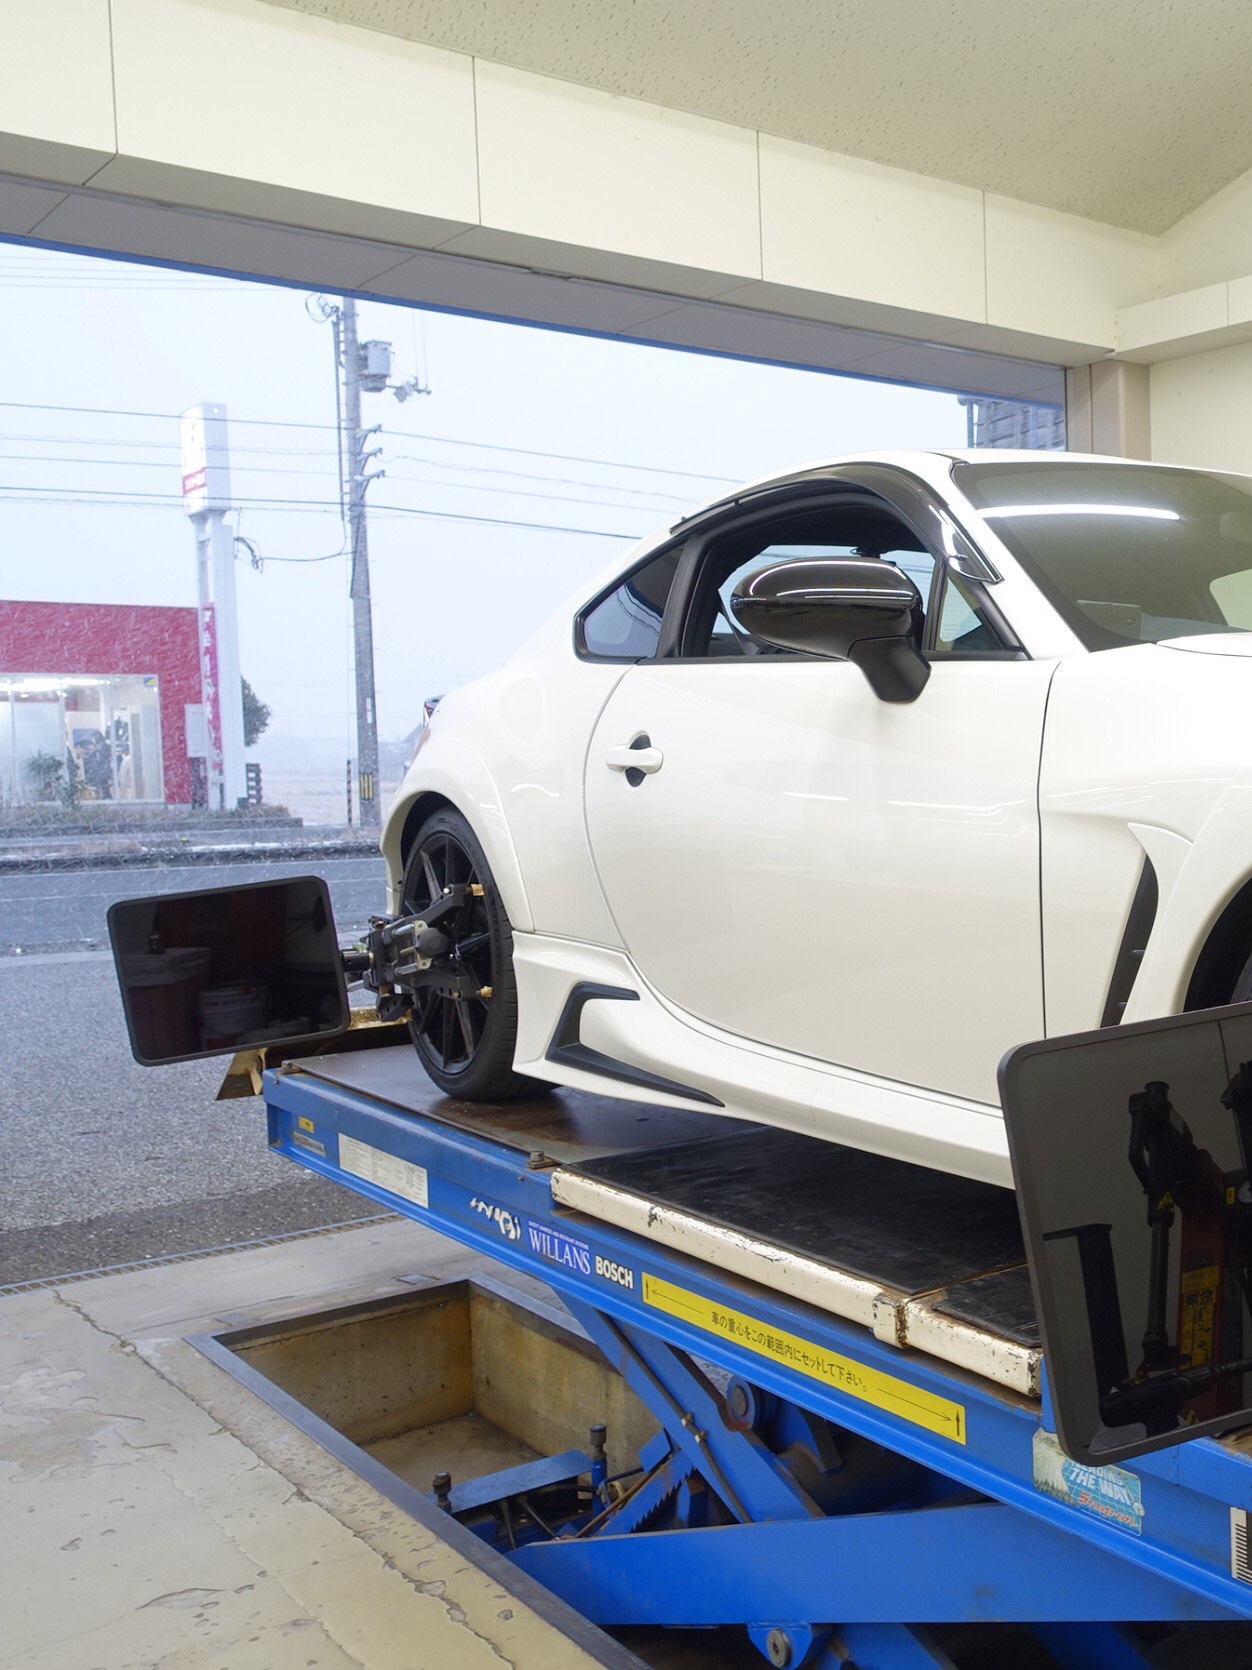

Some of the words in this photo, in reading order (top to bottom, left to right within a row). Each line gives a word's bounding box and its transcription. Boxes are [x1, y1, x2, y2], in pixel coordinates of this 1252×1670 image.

[528, 1227, 591, 1276] WILLANS
[595, 1255, 634, 1290] BOSCH
[711, 1311, 868, 1393] 車の重心をこの範囲内にセットして下さい。
[1069, 1467, 1097, 1490] THE
[1098, 1477, 1132, 1506] WAY
[1078, 1493, 1136, 1526] Snap-on
